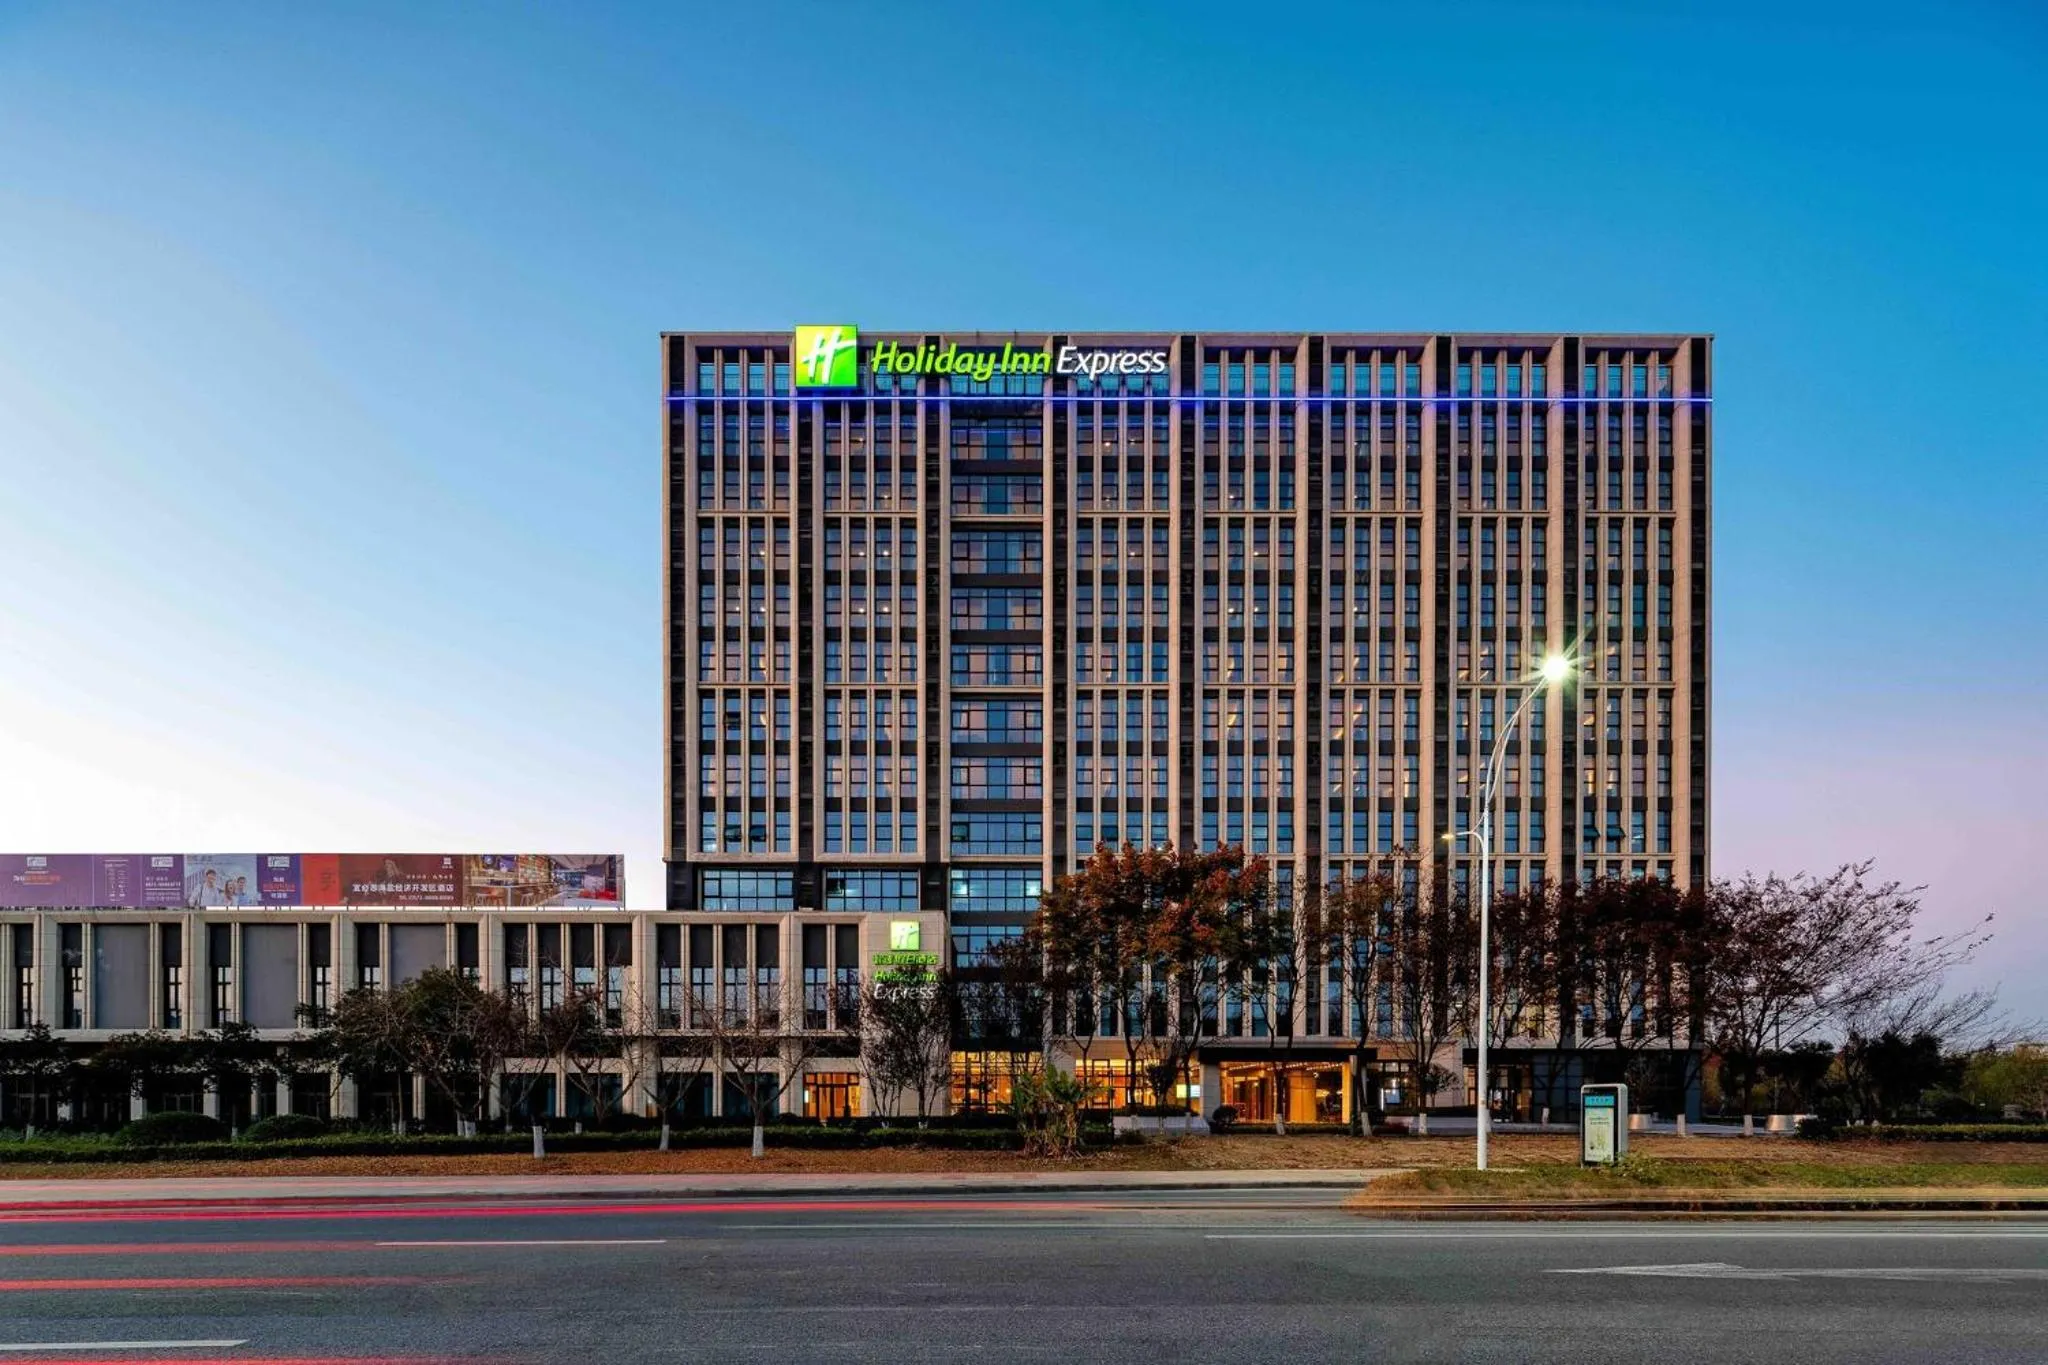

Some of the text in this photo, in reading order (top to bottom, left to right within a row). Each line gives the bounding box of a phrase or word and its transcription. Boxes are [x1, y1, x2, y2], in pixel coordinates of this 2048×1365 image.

[871, 341, 1166, 382] Holiday Inn Express
